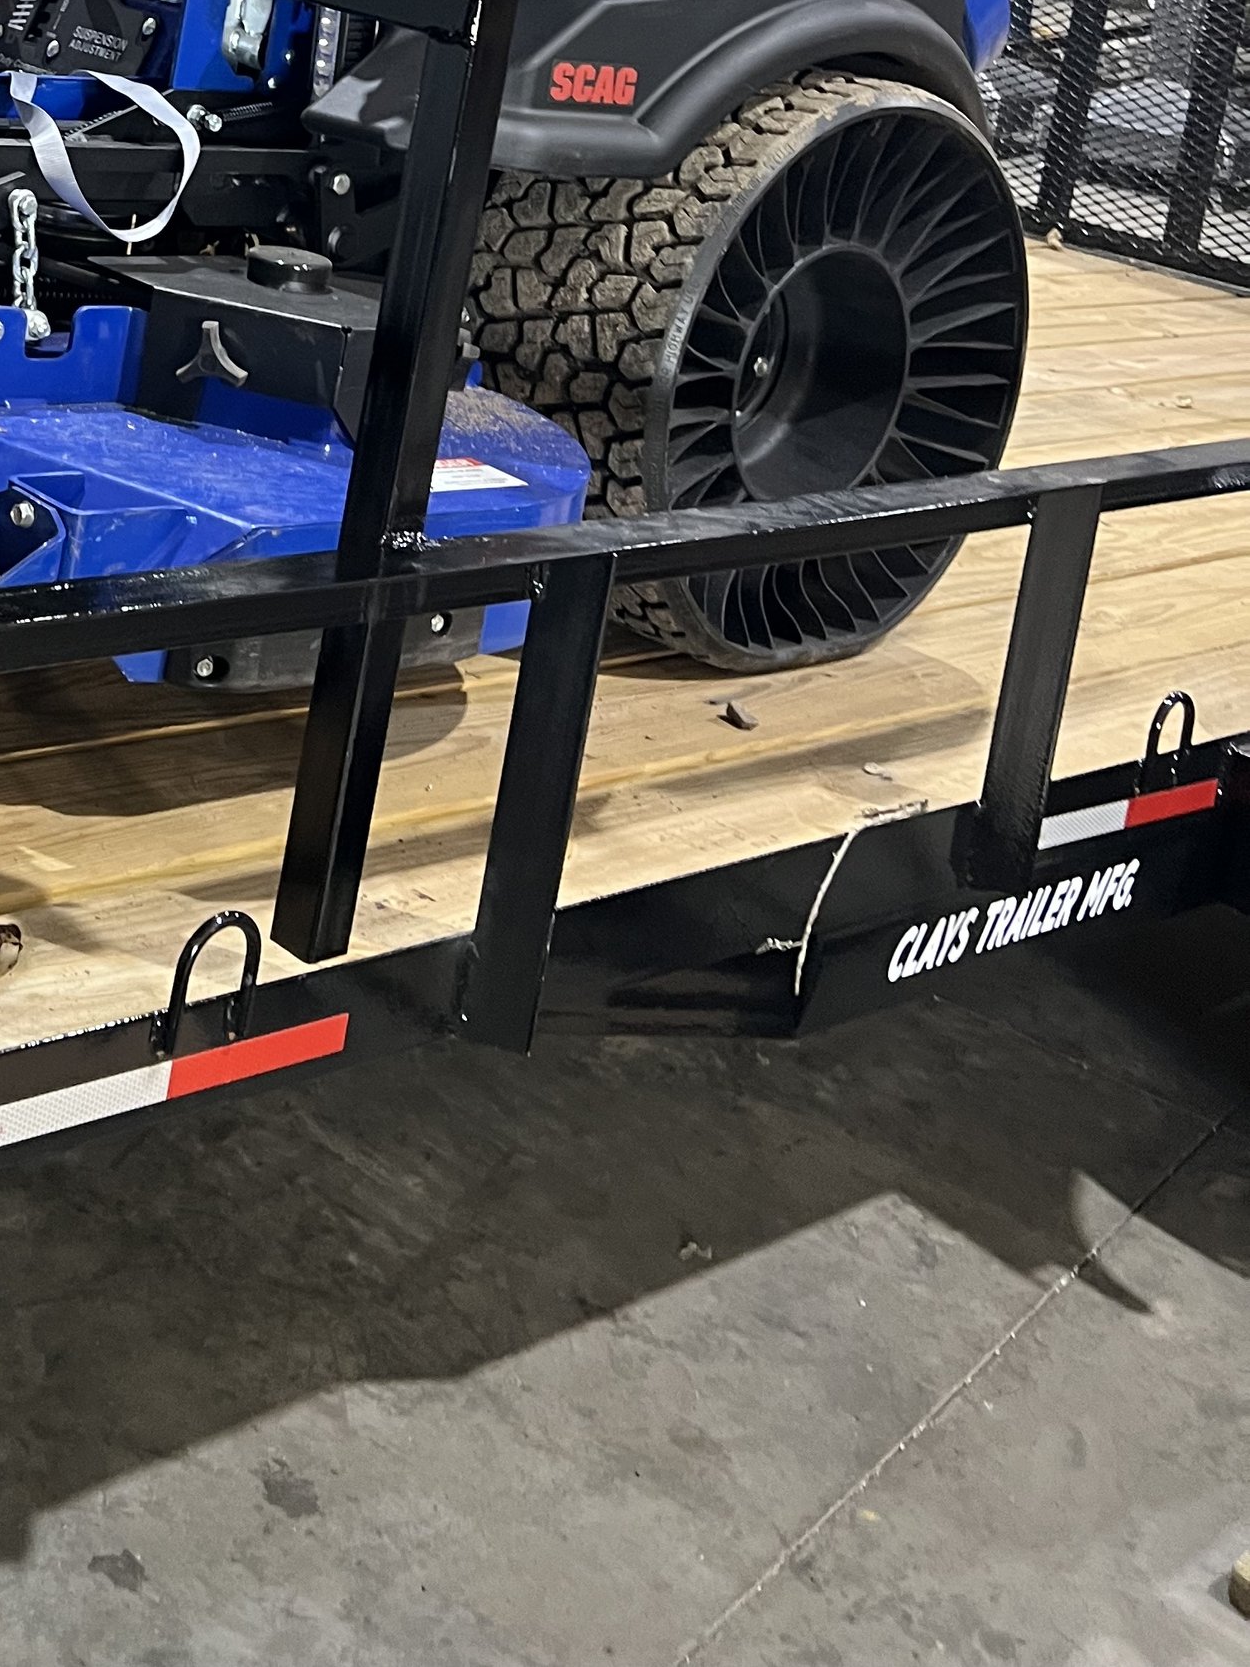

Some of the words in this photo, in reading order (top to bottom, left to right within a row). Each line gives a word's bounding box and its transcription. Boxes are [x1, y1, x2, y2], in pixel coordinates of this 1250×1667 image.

[68, 38, 123, 62] ADJUSTMENT
[72, 25, 129, 52] SUSPENSION
[550, 61, 638, 106] SCAG
[888, 906, 980, 983] CLAYS
[975, 875, 1083, 955] TRAILER
